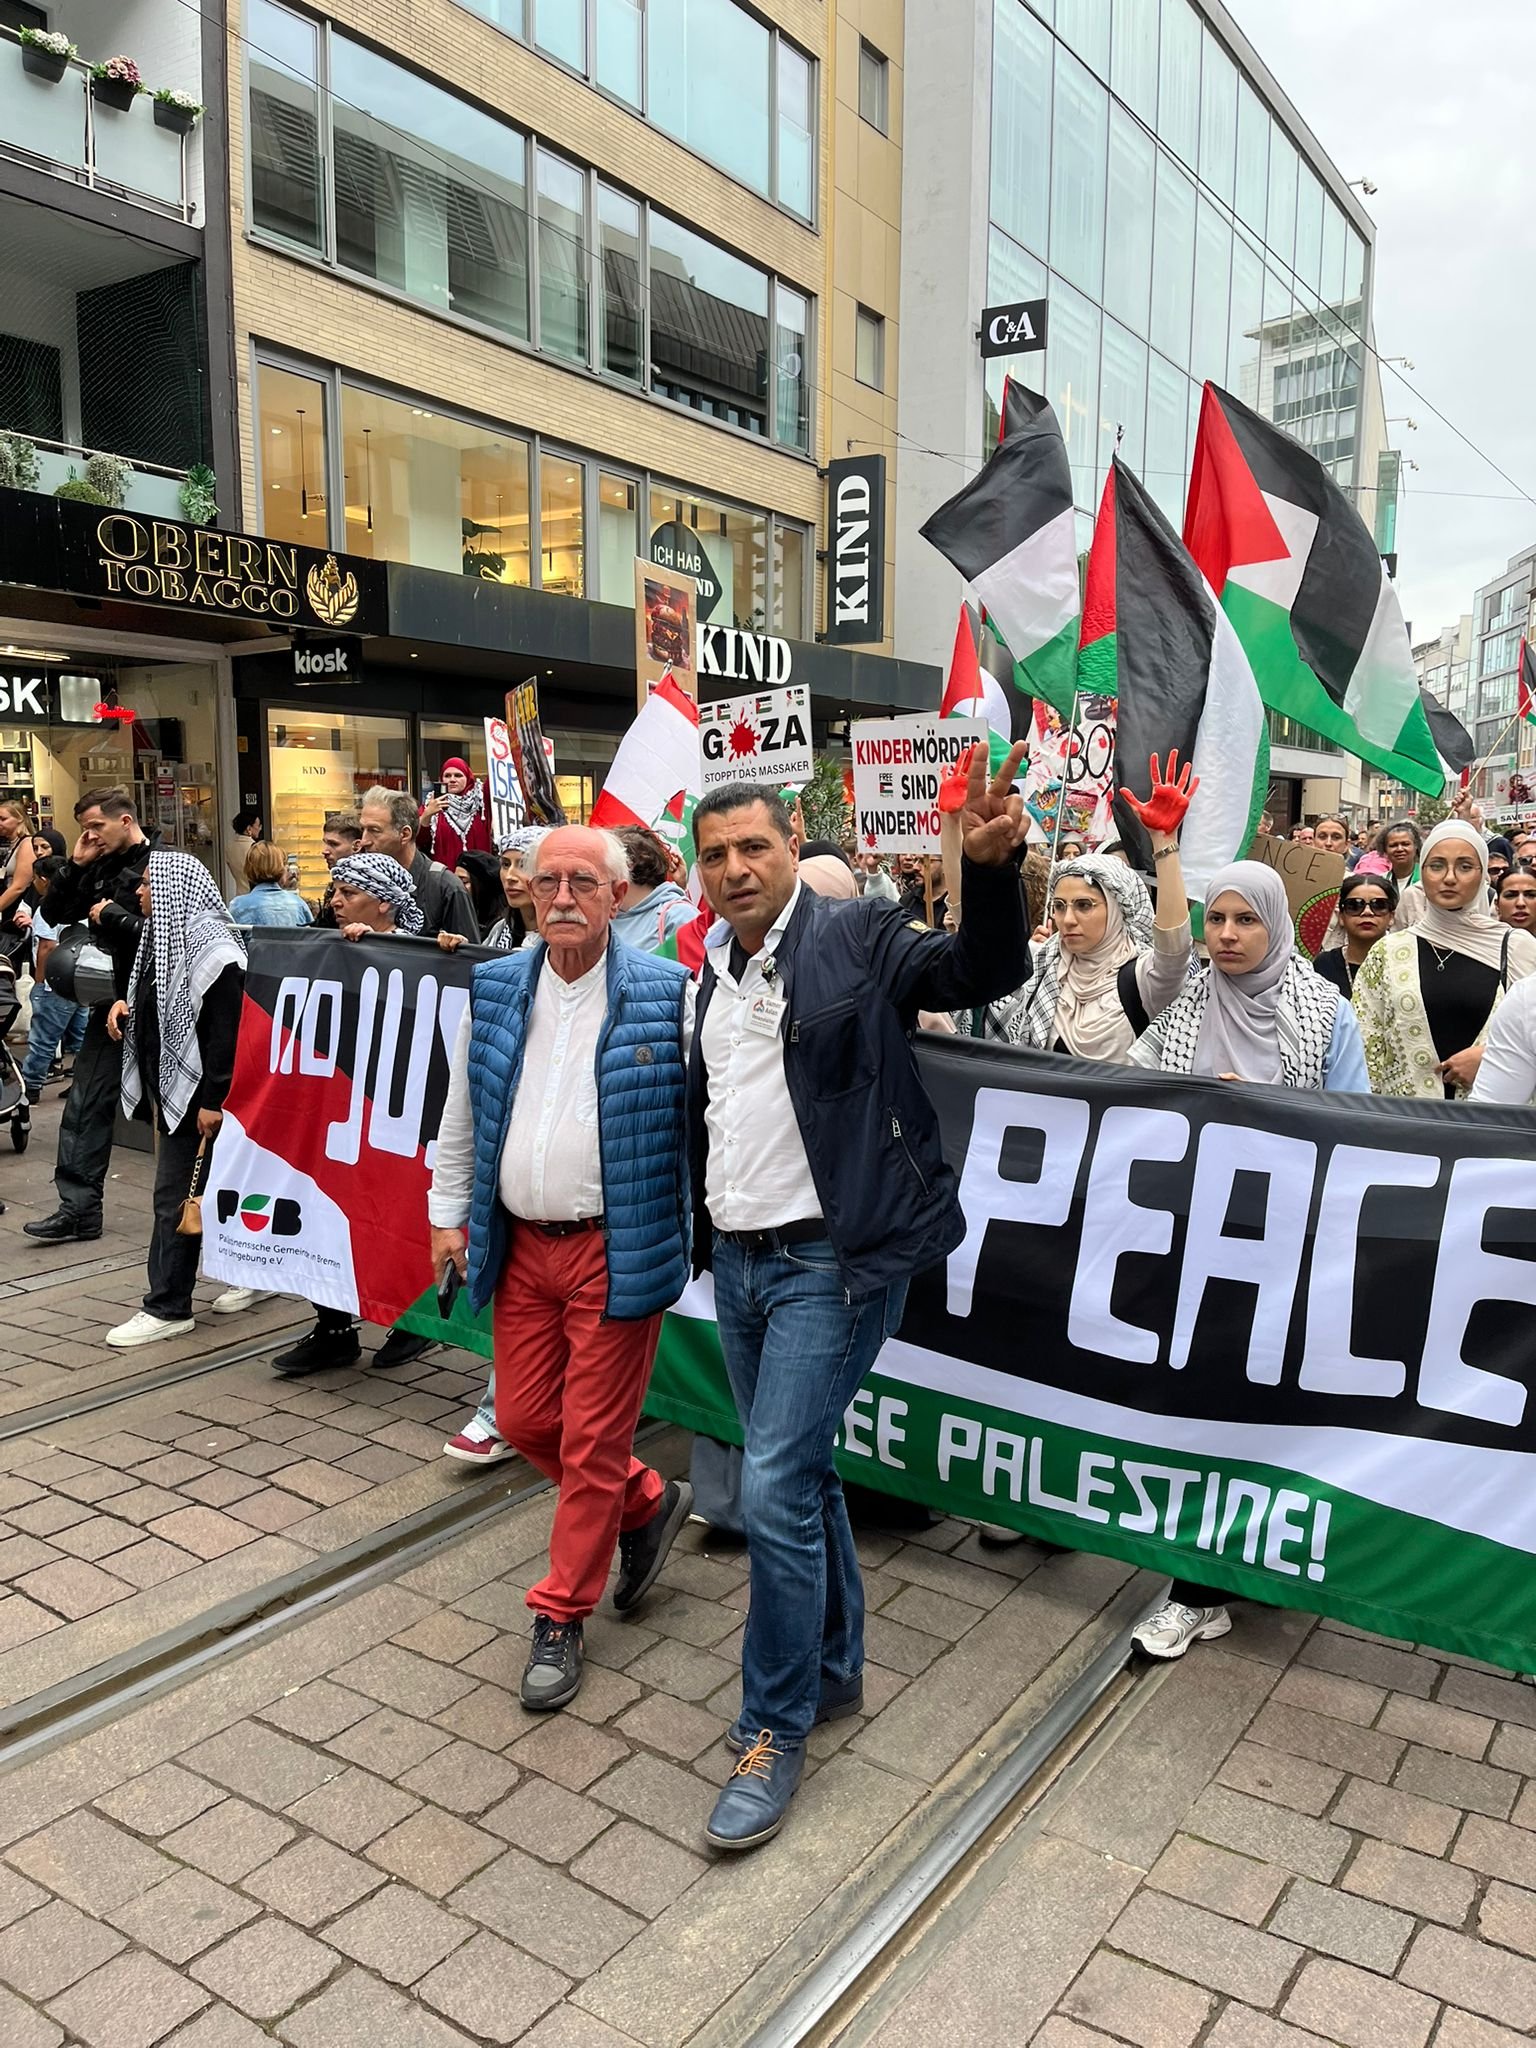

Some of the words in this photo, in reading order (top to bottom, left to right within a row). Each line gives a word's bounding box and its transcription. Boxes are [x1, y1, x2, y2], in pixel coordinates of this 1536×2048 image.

[989, 311, 1037, 345] C&A
[97, 515, 298, 589] OBERN
[654, 544, 674, 567] ICH
[677, 550, 702, 573] HAB
[836, 475, 870, 626] KIND
[99, 558, 300, 617] TOBACCO
[696, 578, 715, 598] ND
[295, 647, 348, 674] kiosk
[696, 622, 792, 685] KIND
[856, 729, 981, 765] KINDERMÖRD
[302, 766, 327, 776] KIND
[704, 769, 737, 783] STOPPT
[738, 767, 757, 779] DAS
[758, 760, 809, 776] MASSAKER
[901, 774, 938, 800] SIND
[946, 1087, 1536, 1427] PEACE
[833, 1388, 909, 1470] EE
[938, 1413, 1332, 1583] PALESTINE!
